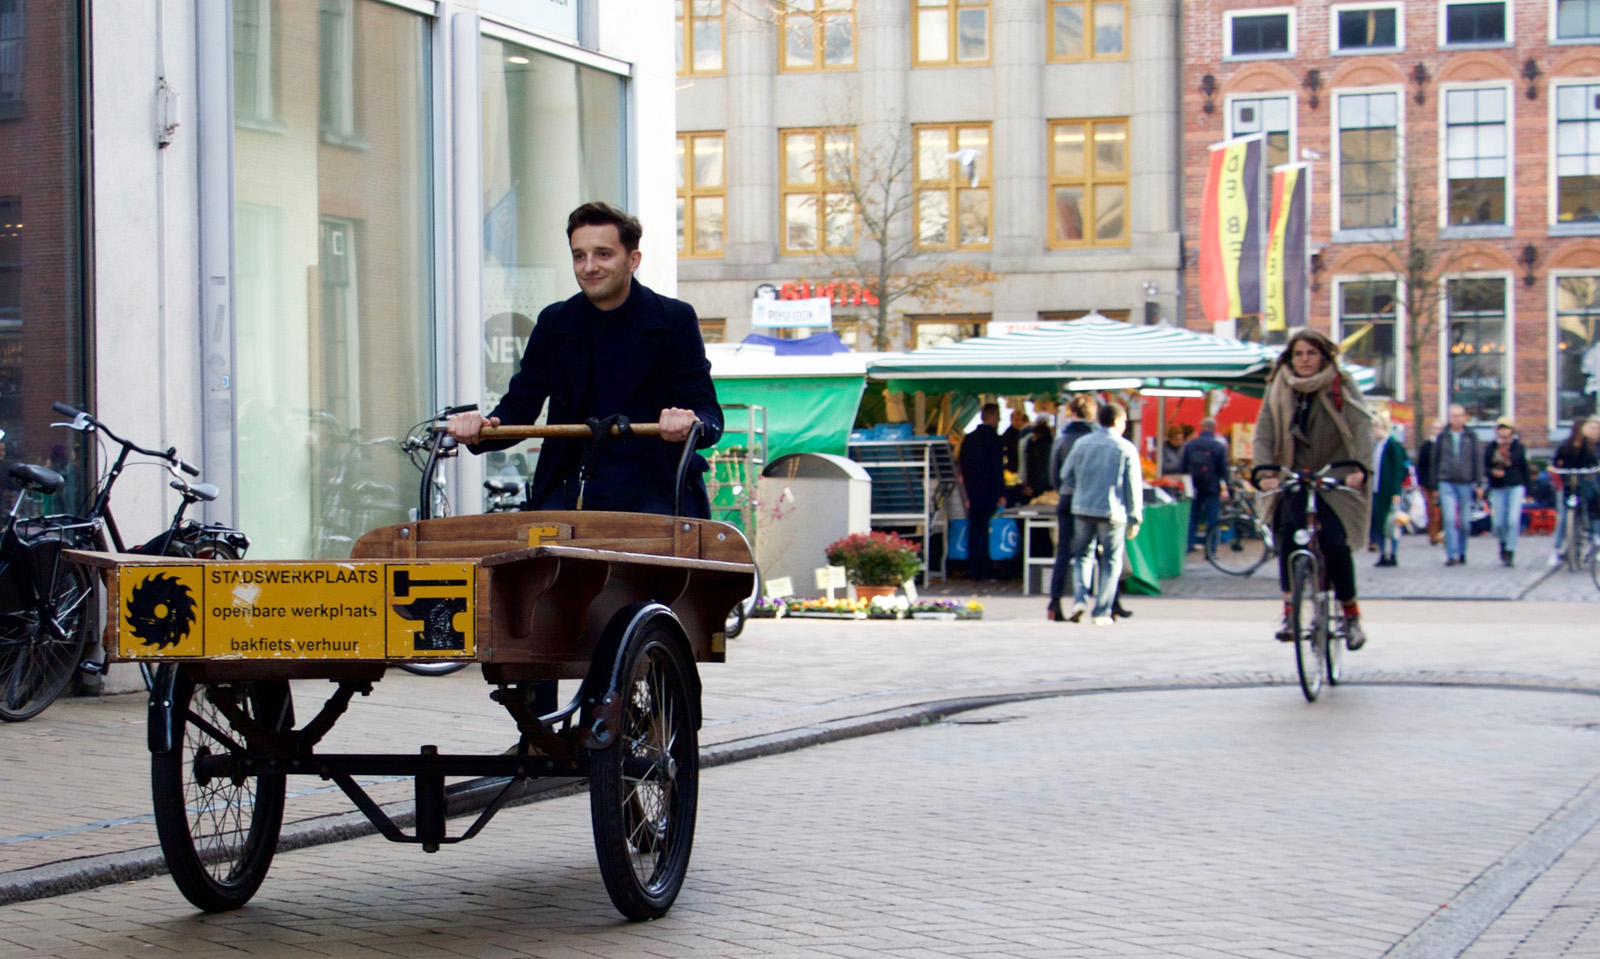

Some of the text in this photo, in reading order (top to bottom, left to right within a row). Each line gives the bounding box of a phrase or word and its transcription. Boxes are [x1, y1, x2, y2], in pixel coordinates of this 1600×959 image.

[211, 570, 378, 584] STADSWERKPLAATS
[212, 603, 287, 621] openbare
[230, 637, 359, 651] bakfiets verhuur
